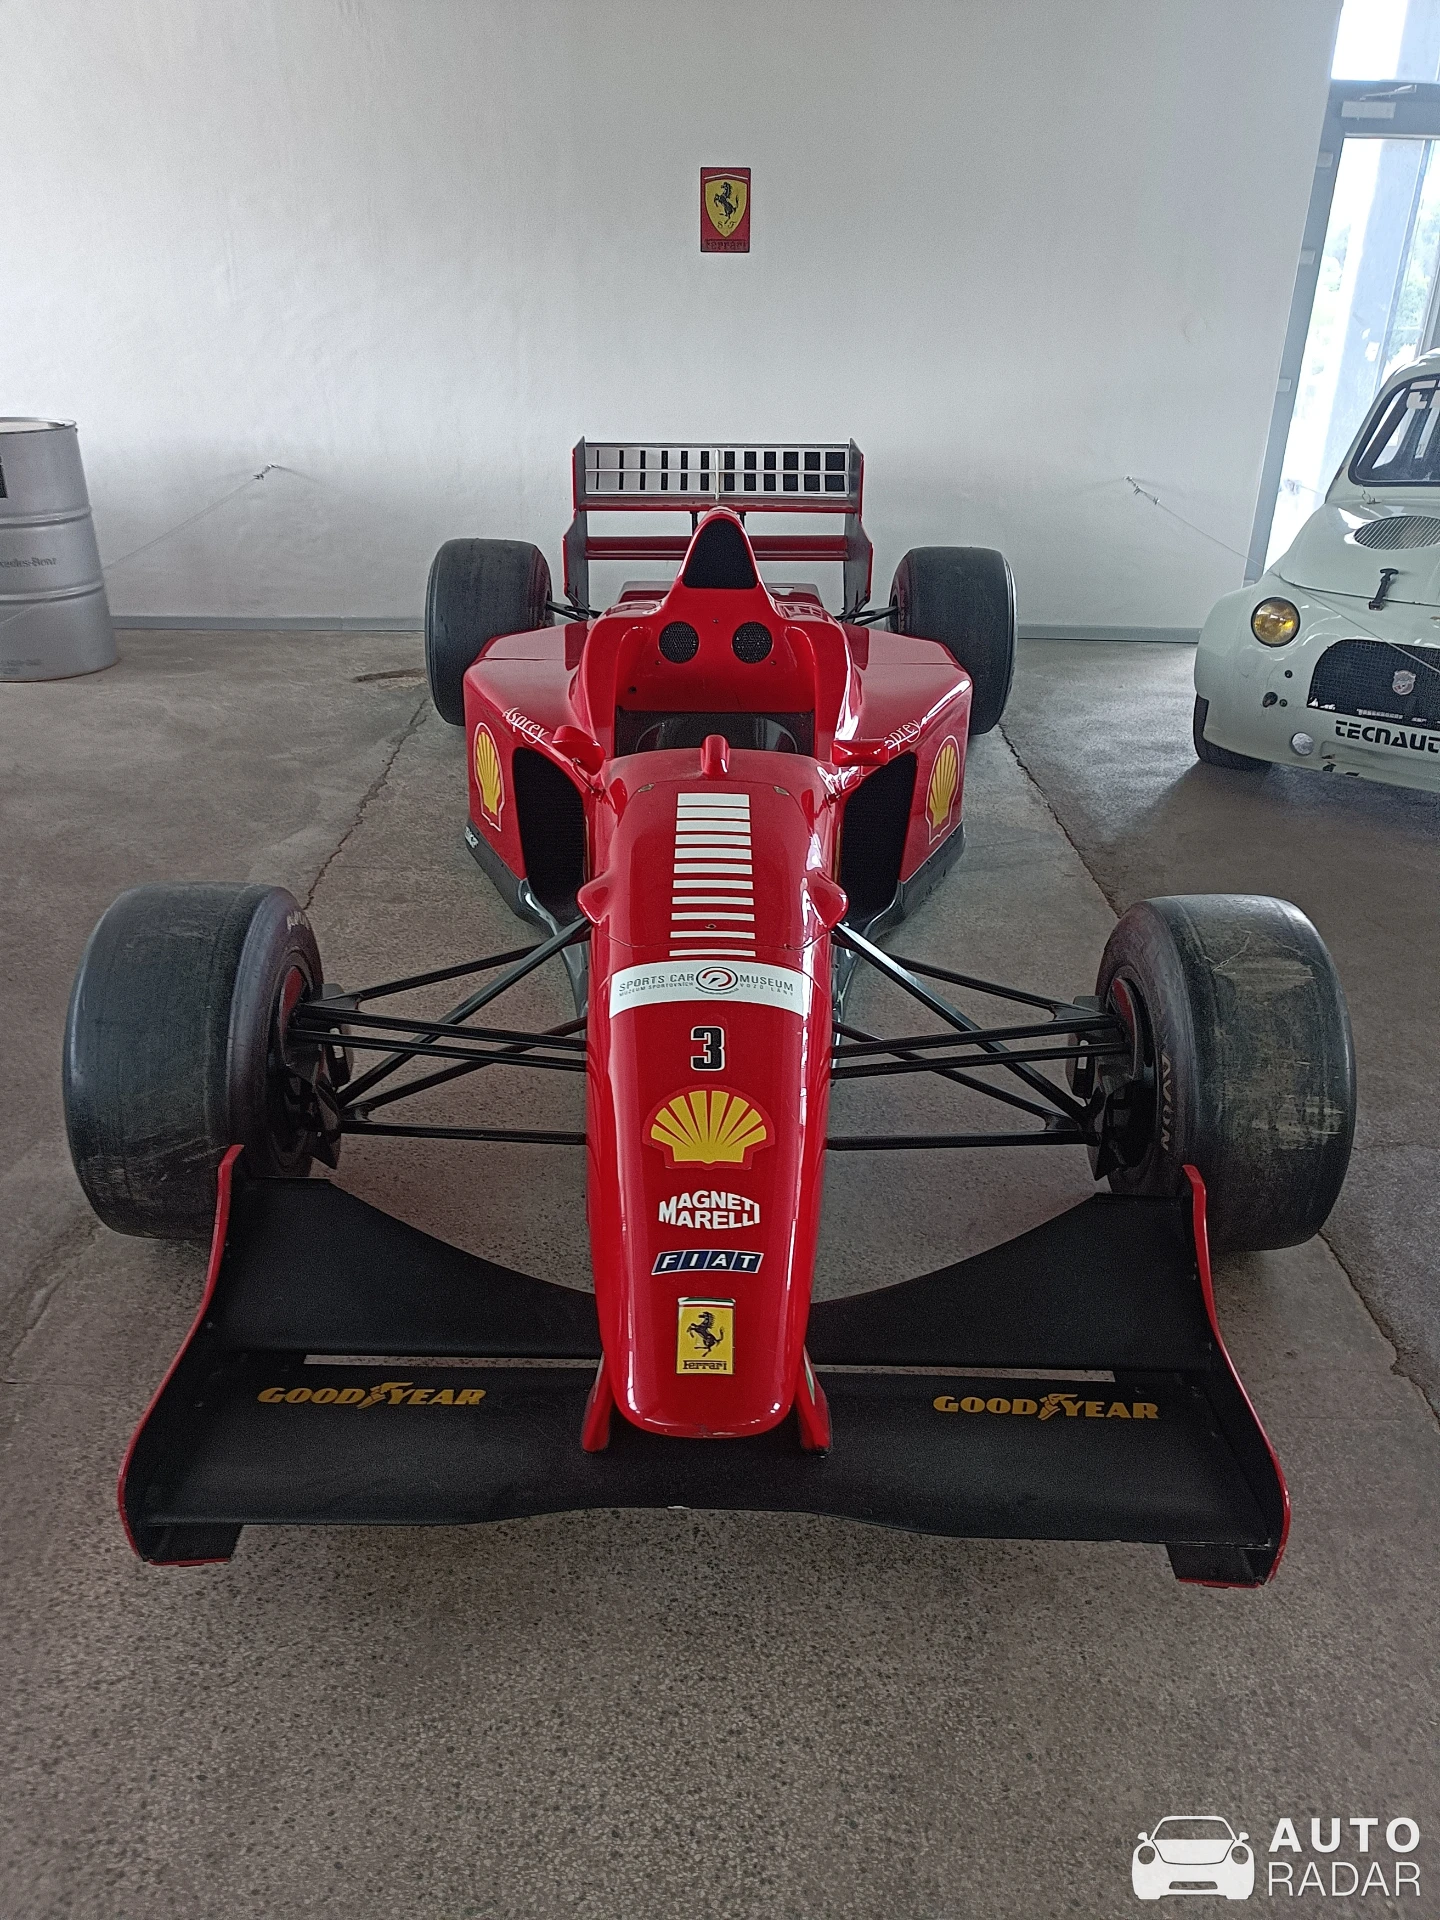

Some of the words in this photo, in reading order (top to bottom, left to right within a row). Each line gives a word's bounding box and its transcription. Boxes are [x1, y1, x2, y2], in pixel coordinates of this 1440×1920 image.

[704, 239, 747, 251] Ferrari
[619, 975, 665, 992] SPORTS
[670, 973, 695, 983] CAR
[740, 974, 794, 991] MUSEUM
[691, 1025, 725, 1071] 3
[659, 1190, 760, 1215] MAGNETI
[659, 1206, 760, 1229] MARELLI
[660, 1252, 756, 1269] FIAT
[682, 1360, 727, 1371] Ferrari
